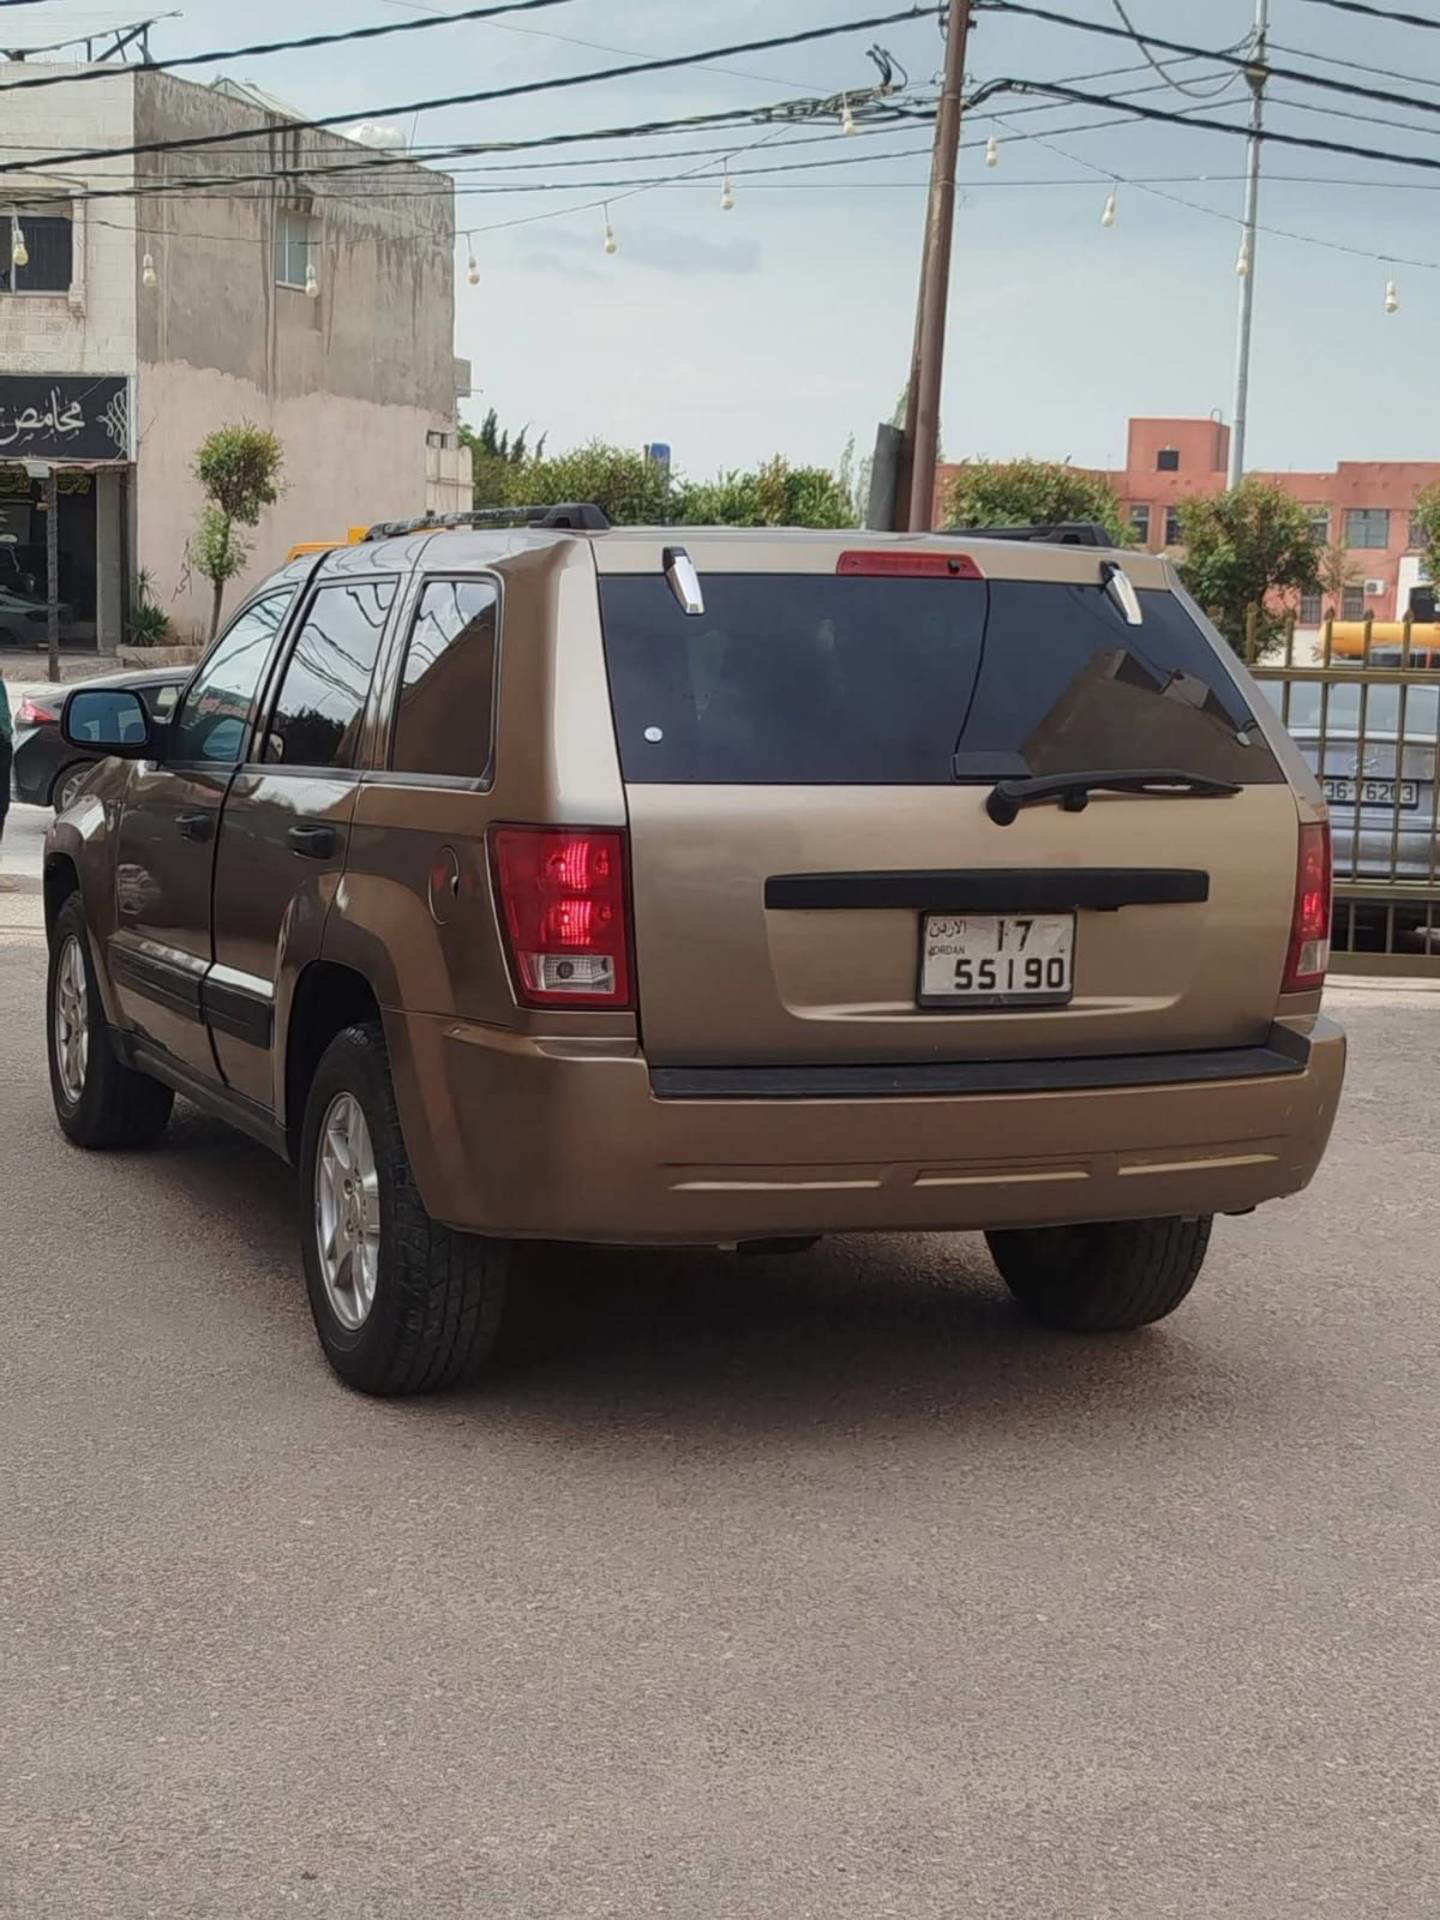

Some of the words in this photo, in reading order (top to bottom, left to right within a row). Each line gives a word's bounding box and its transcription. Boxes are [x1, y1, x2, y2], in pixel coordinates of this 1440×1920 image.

[1324, 781, 1413, 802] 36-623
[998, 920, 1034, 951] 17
[955, 958, 1064, 990] 55190
